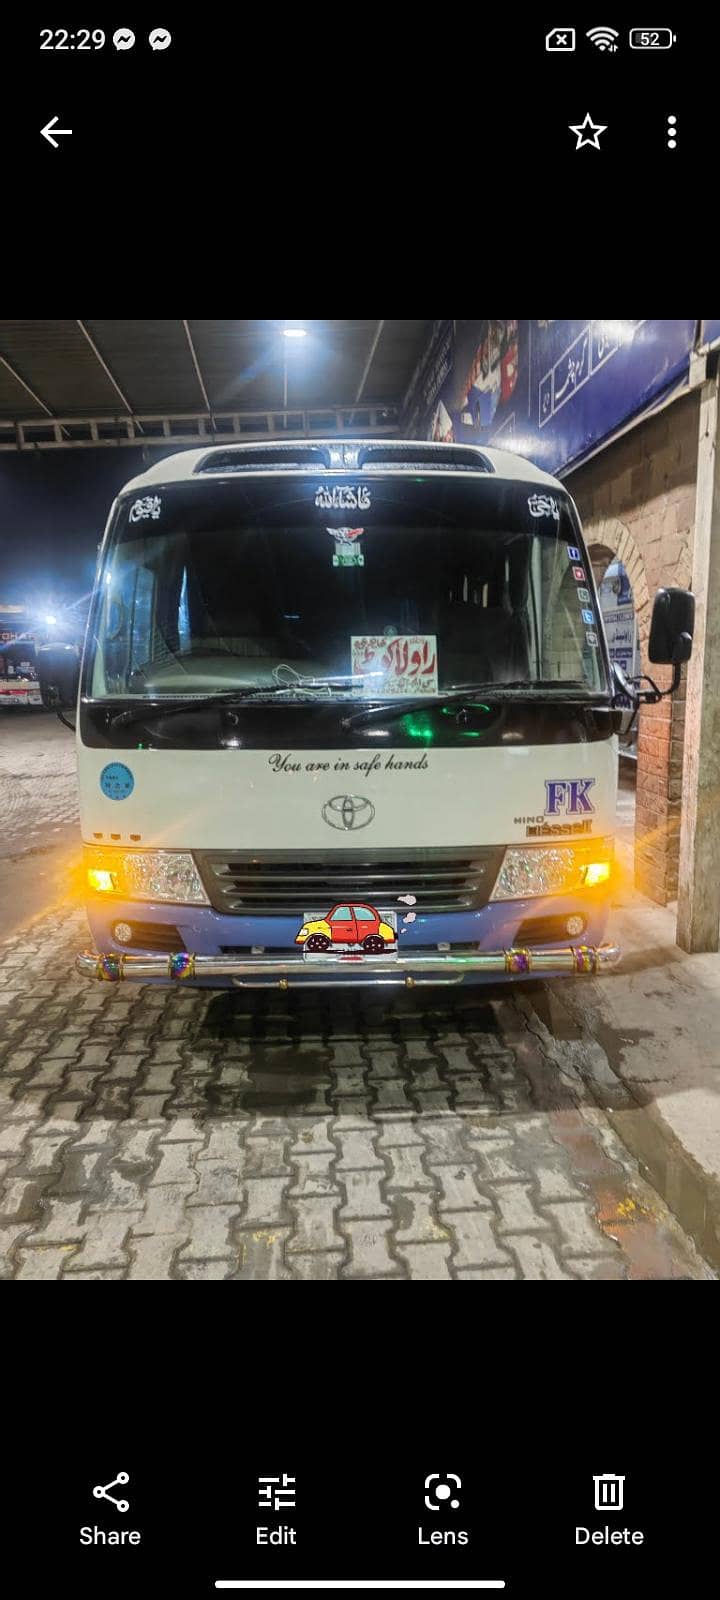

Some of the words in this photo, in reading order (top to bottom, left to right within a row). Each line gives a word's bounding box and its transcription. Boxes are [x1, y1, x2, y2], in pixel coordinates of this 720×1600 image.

[268, 753, 302, 772] You
[305, 762, 330, 772] are
[334, 757, 350, 771] in
[353, 753, 382, 778] safe
[384, 752, 429, 771] hands
[544, 778, 596, 817] FK
[513, 816, 545, 825] HINO
